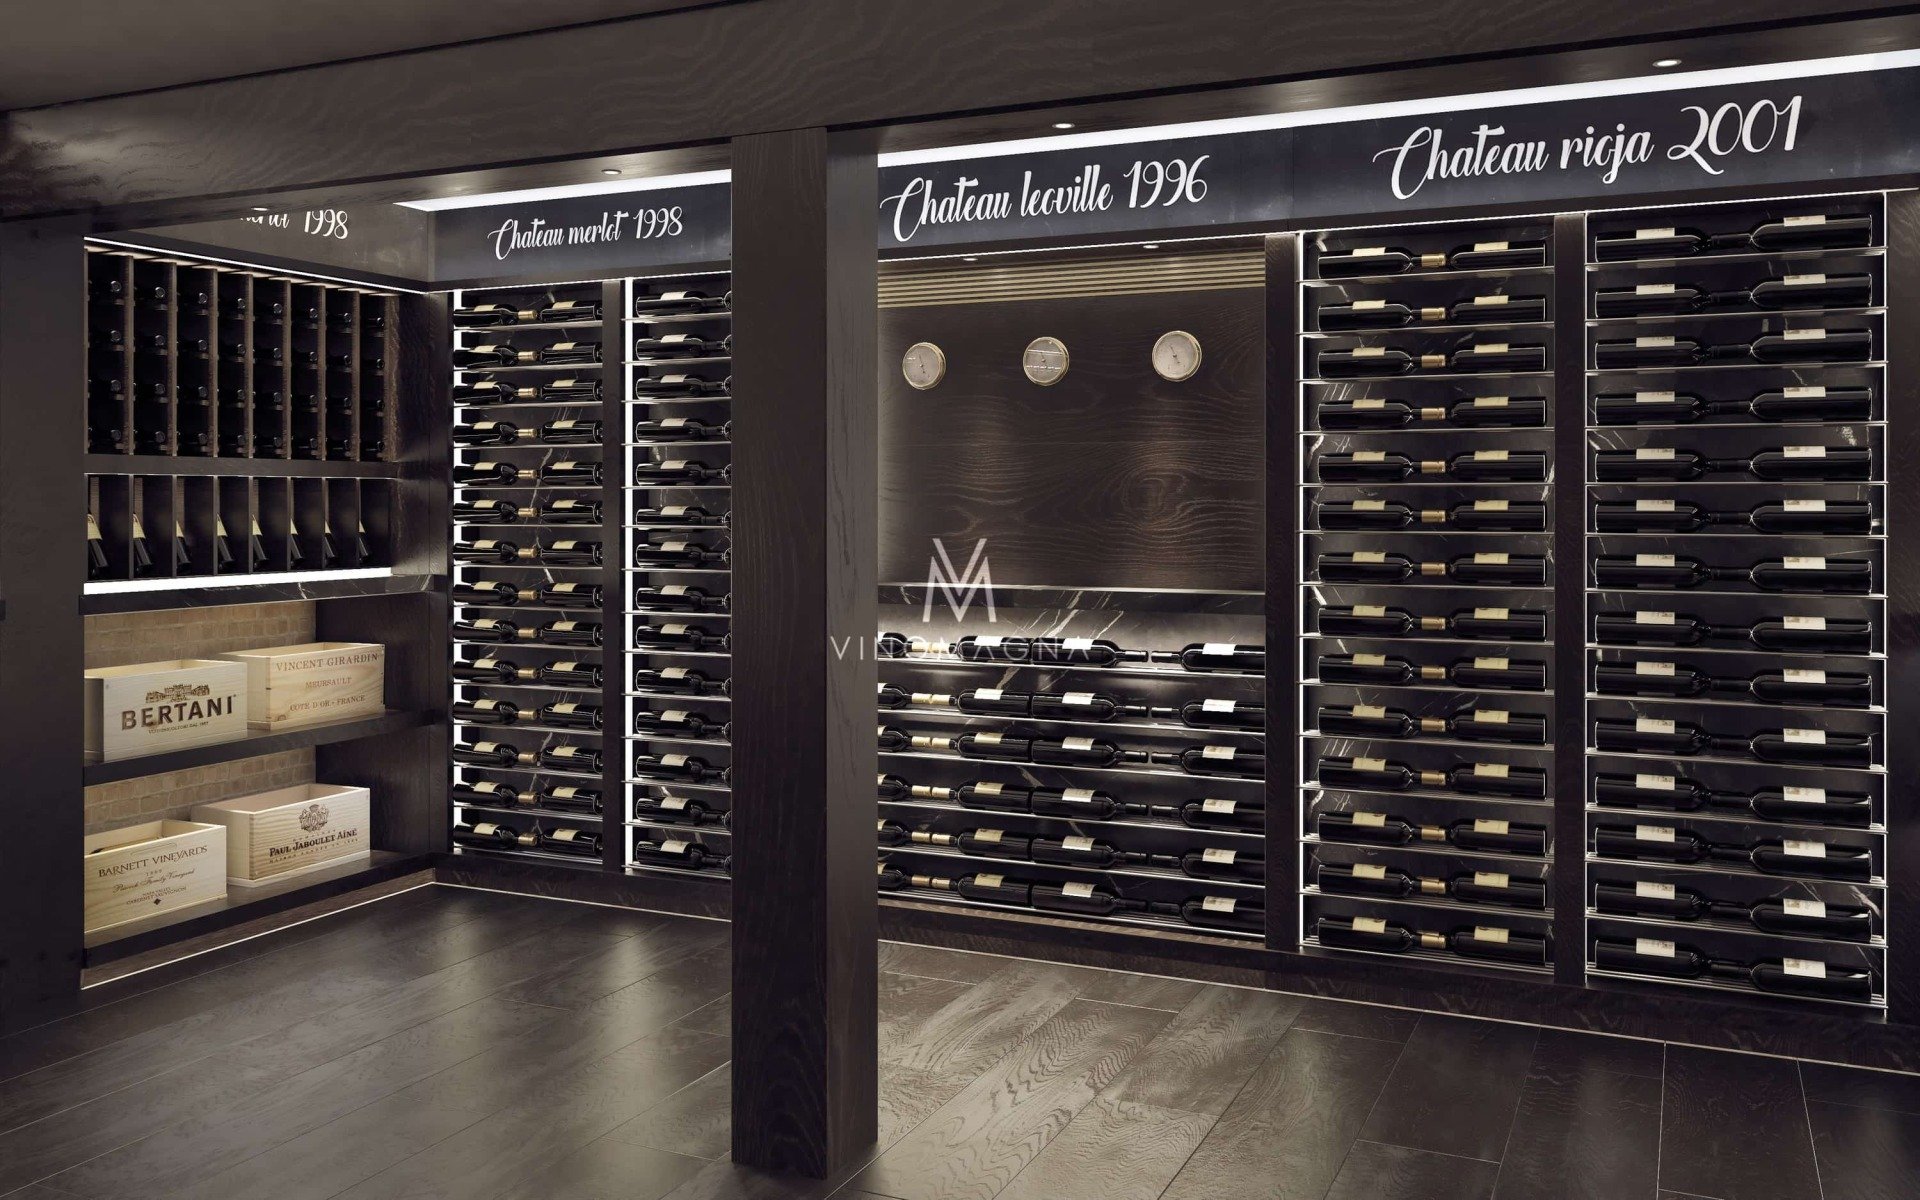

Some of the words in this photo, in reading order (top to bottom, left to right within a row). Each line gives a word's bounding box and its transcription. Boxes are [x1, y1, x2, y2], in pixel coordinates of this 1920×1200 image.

[1372, 124, 1549, 200] Chateau
[1667, 95, 1802, 175] 2001
[880, 176, 1012, 242] Chateau
[1123, 154, 1210, 209] 1996
[304, 208, 348, 239] 1998
[487, 218, 565, 260] Chateau
[568, 210, 629, 244] merlot
[632, 206, 683, 239] 1998
[276, 658, 324, 671] VINCENT
[326, 653, 378, 666] GIRARDIN
[305, 677, 352, 689] MEURSAULT
[121, 696, 232, 731] BERTANI
[336, 695, 366, 706] FRANCE
[98, 858, 149, 877] BARNETT
[152, 845, 208, 864] VINEYARDS
[269, 846, 292, 857] PAUL
[292, 834, 336, 851] JABOULET
